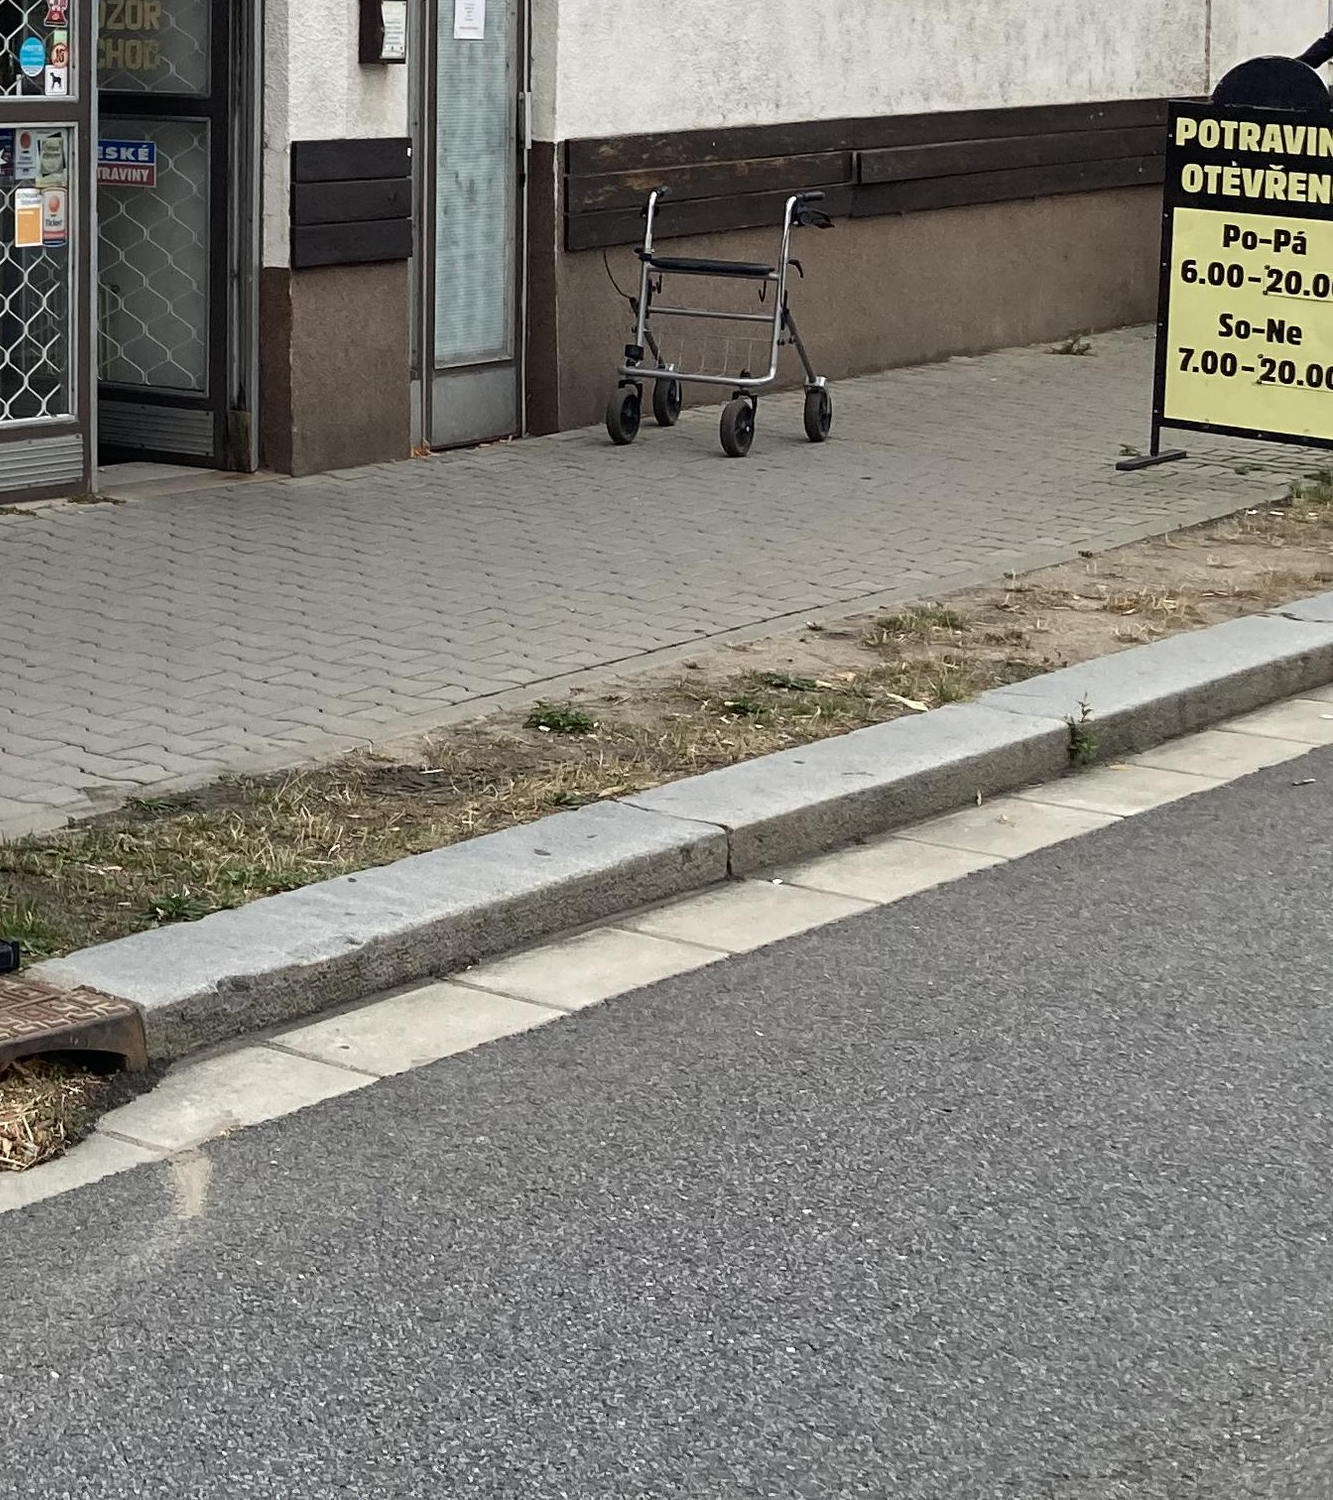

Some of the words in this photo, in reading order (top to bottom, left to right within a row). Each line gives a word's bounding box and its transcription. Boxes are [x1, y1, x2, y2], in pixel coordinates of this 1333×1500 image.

[1175, 116, 1333, 158] POTRAVIN
[98, 167, 149, 182] TRAVINY
[1181, 160, 1333, 204] OTEVŘEN
[1222, 223, 1307, 256] Po-Pá
[1218, 312, 1303, 347] So-Ne
